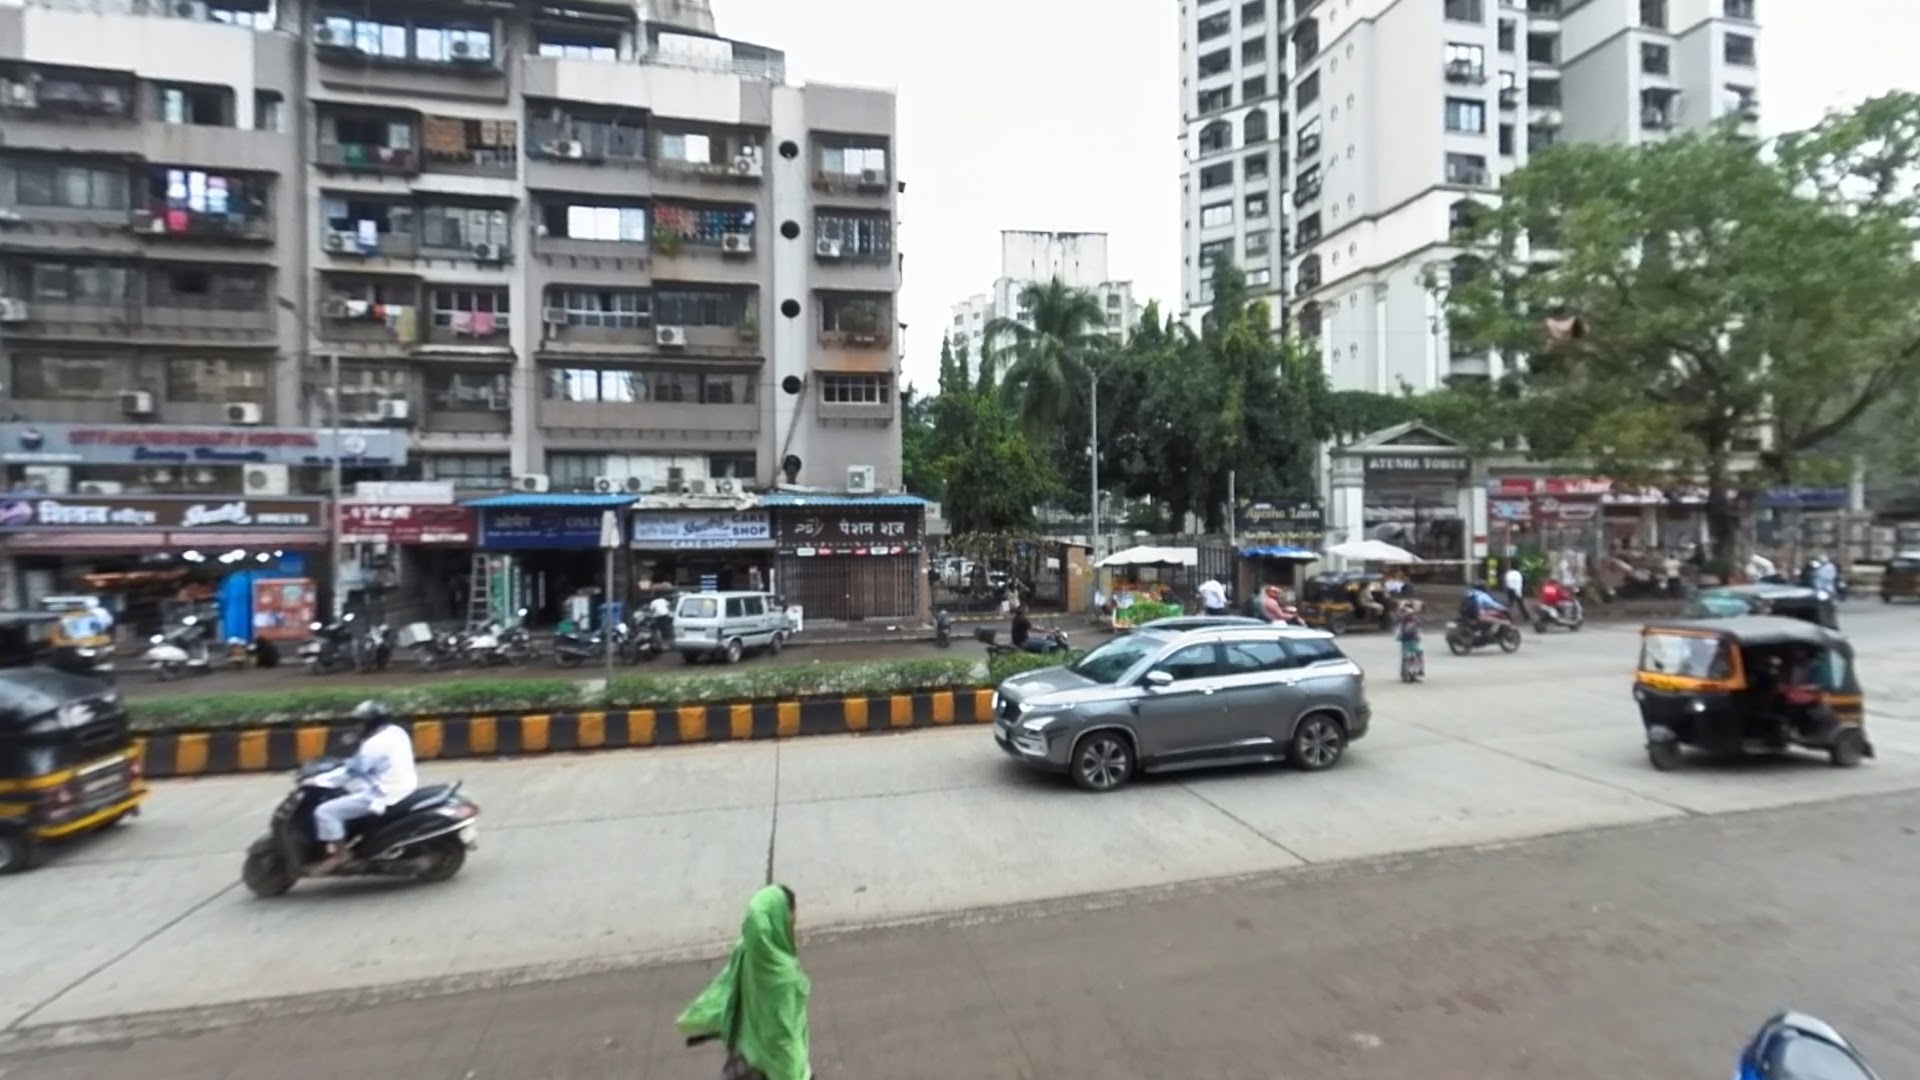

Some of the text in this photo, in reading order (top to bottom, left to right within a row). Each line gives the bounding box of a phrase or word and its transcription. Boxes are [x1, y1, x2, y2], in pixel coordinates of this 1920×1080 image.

[732, 513, 767, 523] CAKE
[732, 526, 768, 536] SHOP
[707, 540, 738, 549] SHOP
